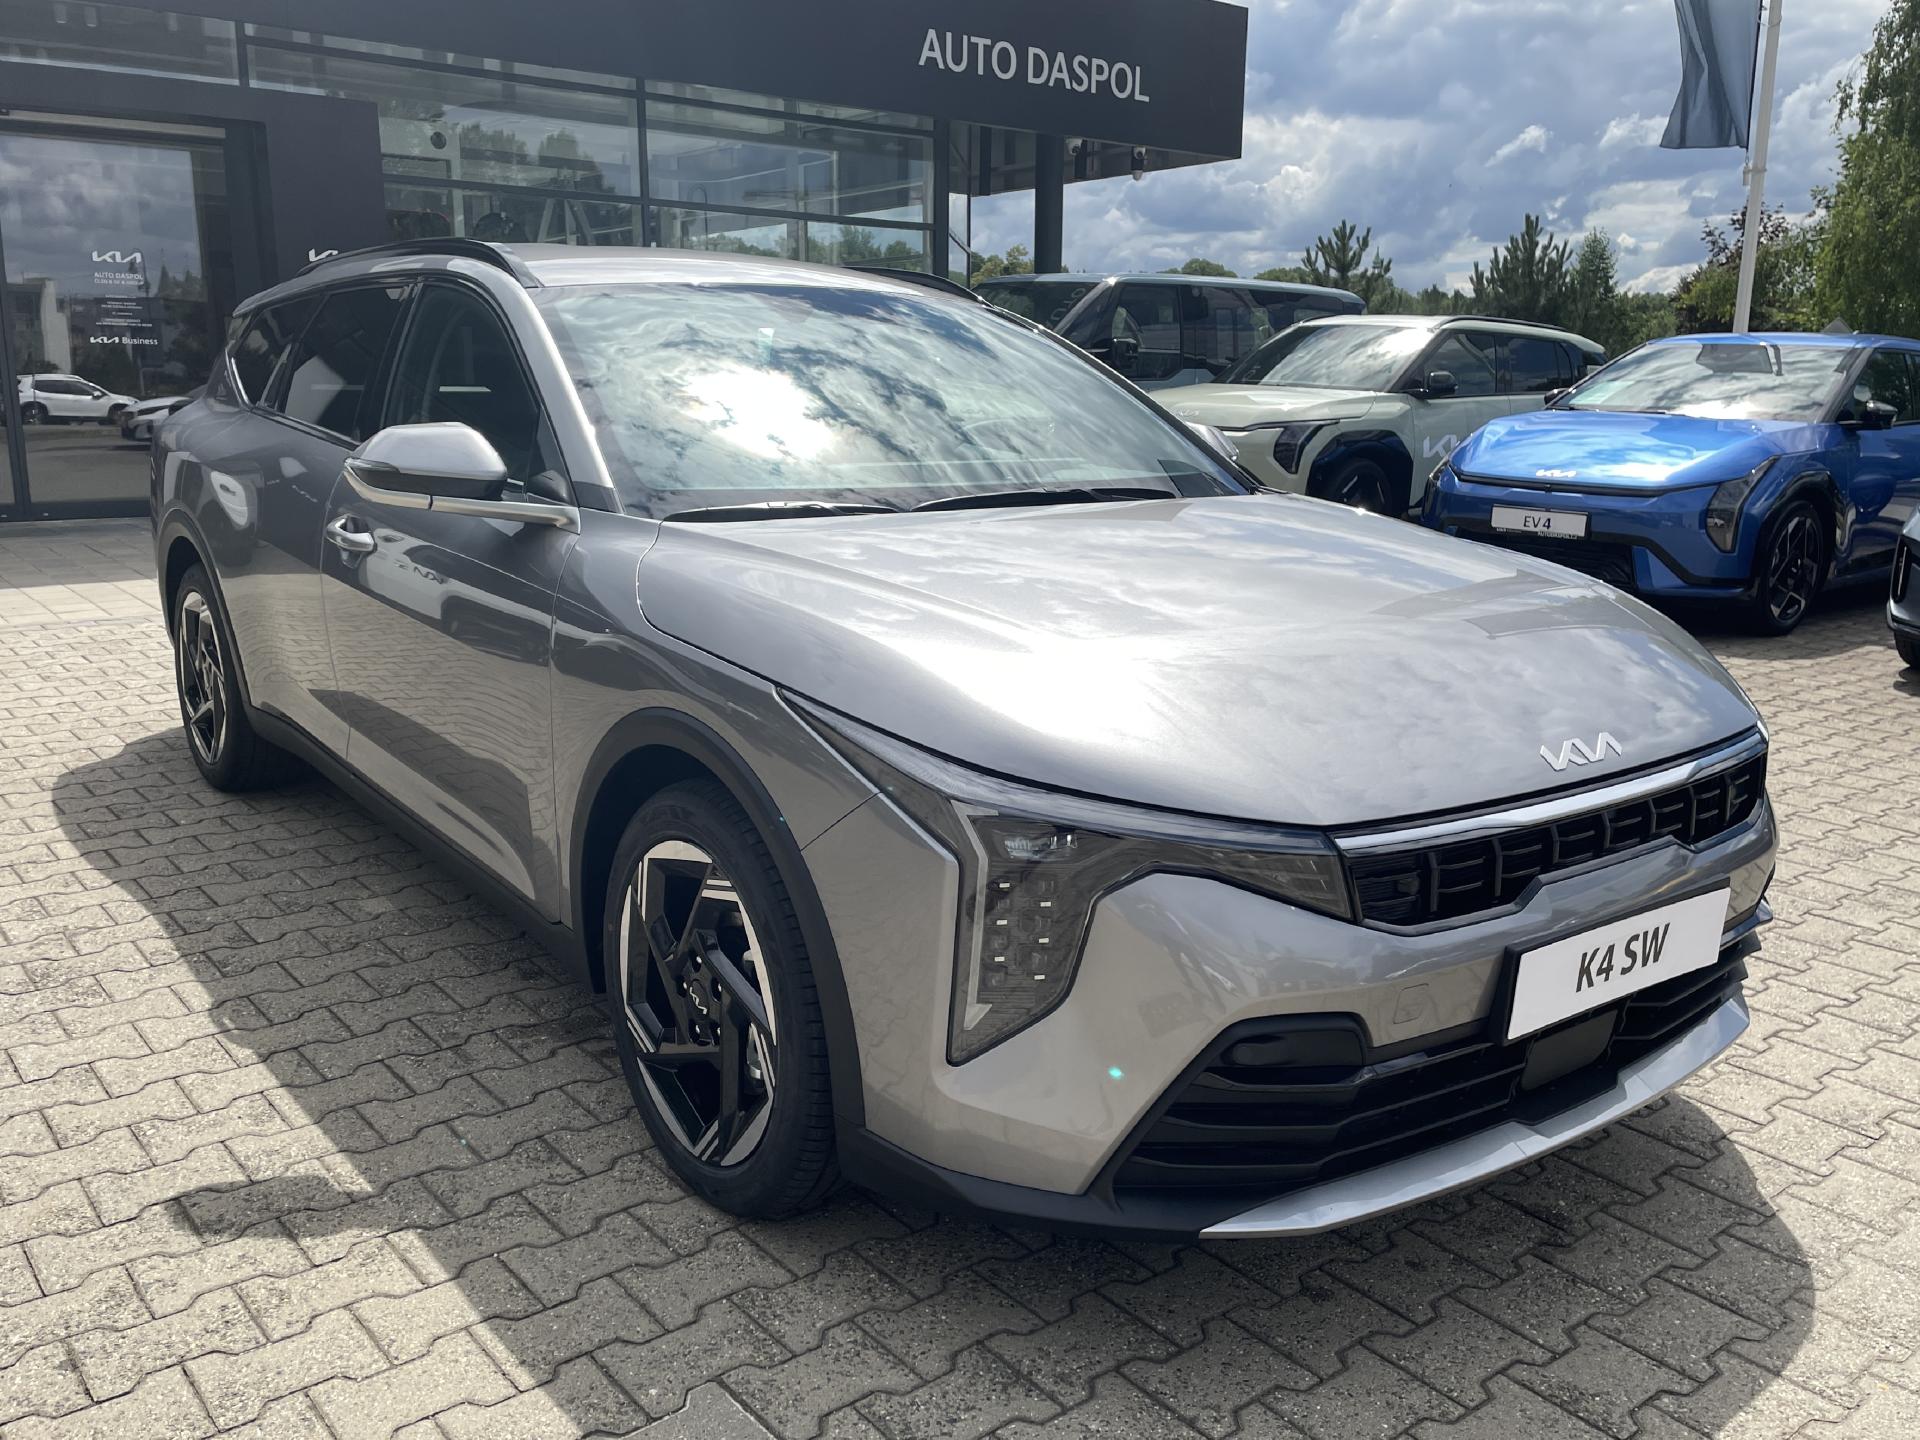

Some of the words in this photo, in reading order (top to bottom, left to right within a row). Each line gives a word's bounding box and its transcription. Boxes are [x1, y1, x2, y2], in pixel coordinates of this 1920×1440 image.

[918, 28, 1018, 80] AUTO
[1027, 46, 1150, 103] DASPOL
[92, 251, 142, 263] KIA
[94, 271, 114, 279] AUTO
[115, 272, 144, 280] DASPOL
[89, 336, 119, 344] KIA
[121, 336, 158, 345] Business
[1423, 434, 1457, 458] KI
[1535, 468, 1577, 478] KIA
[1539, 732, 1623, 771] KIA
[1575, 944, 1614, 993] K4
[1619, 922, 1671, 976] SW
